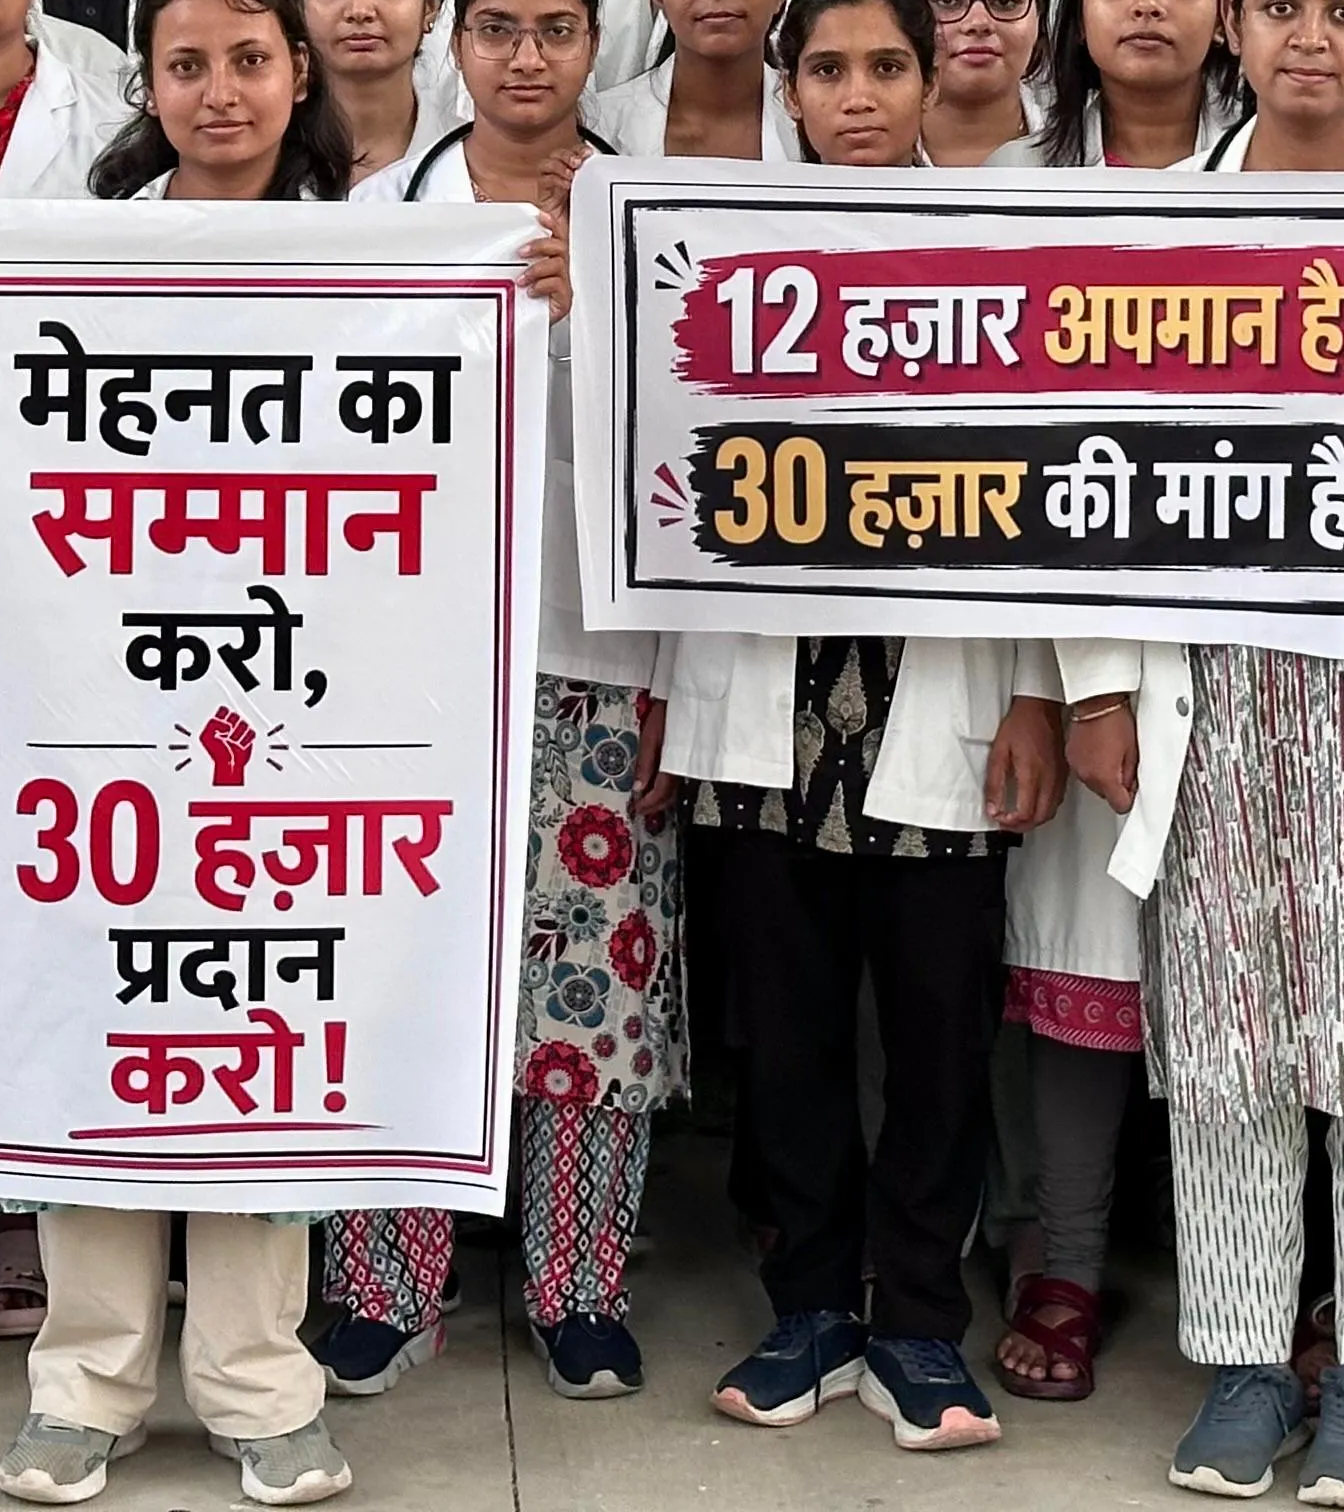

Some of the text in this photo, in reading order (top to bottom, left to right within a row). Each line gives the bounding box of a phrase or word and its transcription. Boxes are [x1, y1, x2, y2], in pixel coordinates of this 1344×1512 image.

[716, 264, 819, 374] 12
[838, 284, 1028, 378] हज़ार
[1044, 284, 1283, 366] अपमान
[12, 319, 463, 458] मेहनत का
[29, 470, 438, 577] सम्मान
[713, 435, 828, 545] 30
[845, 460, 1028, 549] हज़ार
[1041, 434, 1138, 540] की
[1152, 438, 1294, 540] मांग
[120, 583, 329, 709] करो,
[15, 777, 454, 913] 30 हज़ार
[107, 926, 347, 1013] प्रदान
[106, 1007, 347, 1115] करो!
